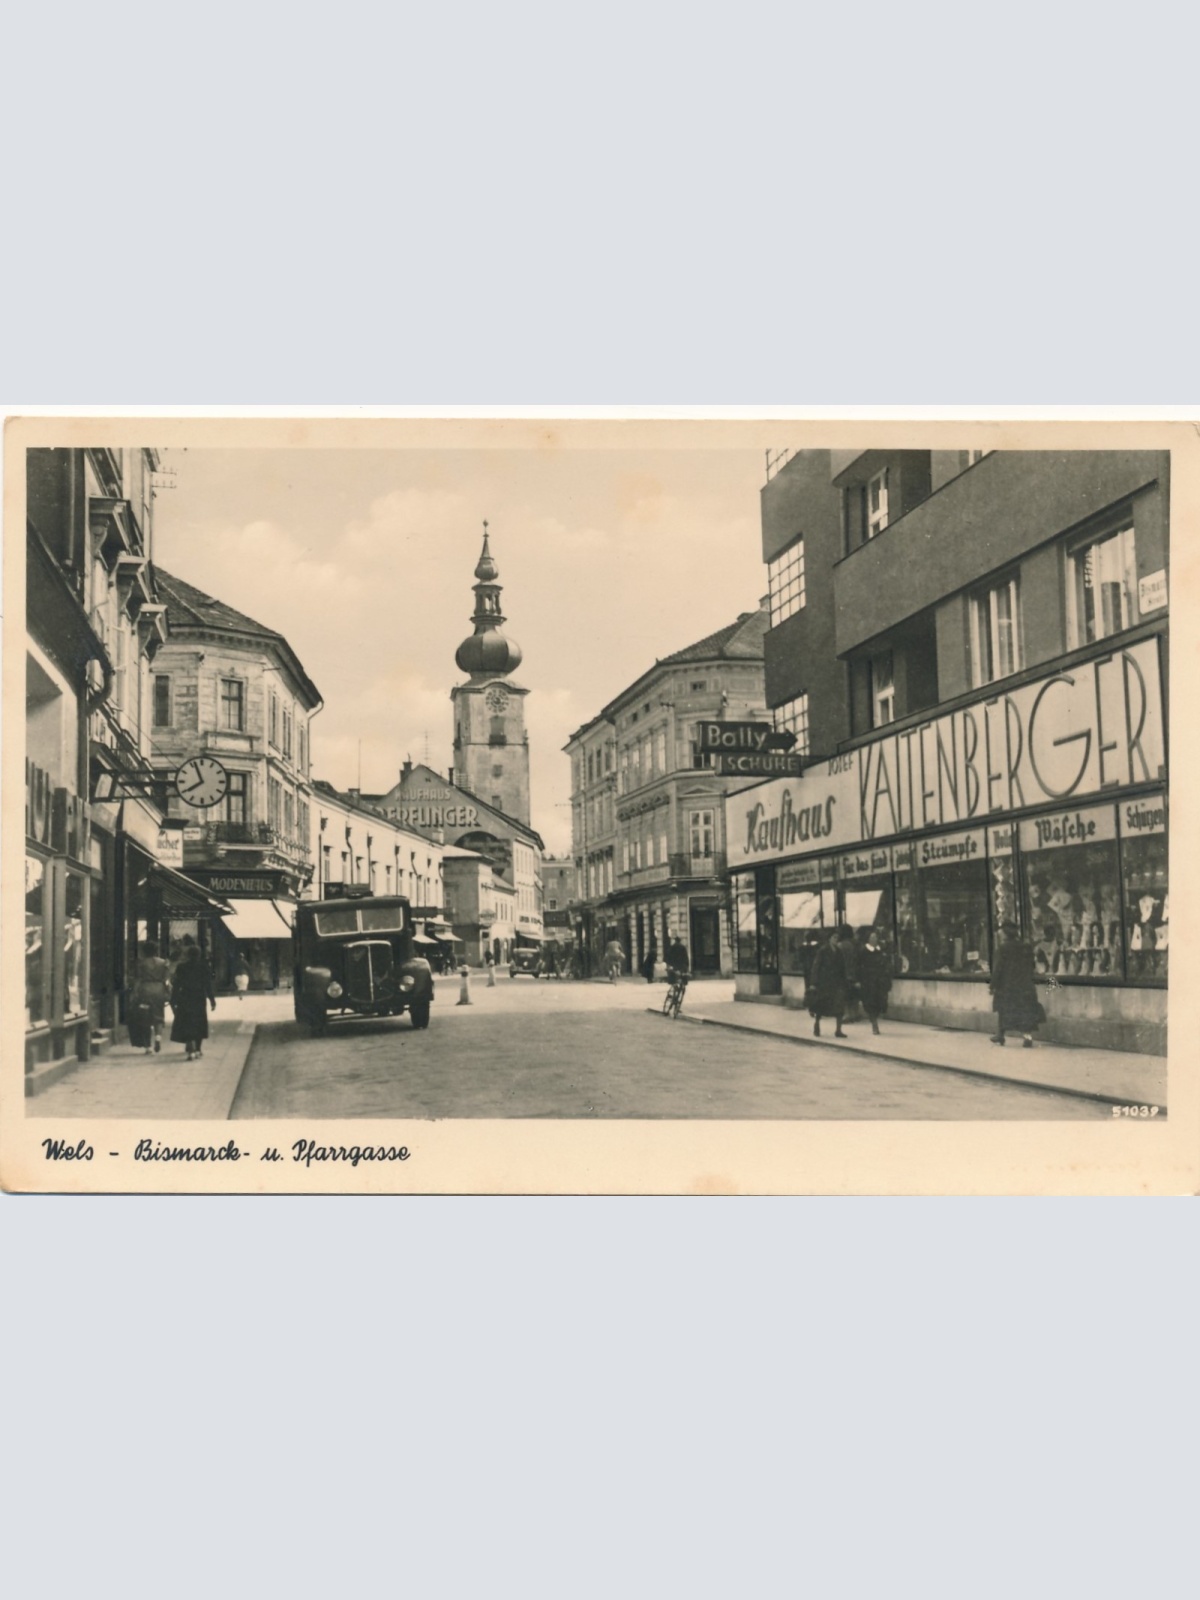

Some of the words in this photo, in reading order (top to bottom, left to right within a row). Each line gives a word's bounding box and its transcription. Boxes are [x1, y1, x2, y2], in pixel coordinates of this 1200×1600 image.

[707, 724, 767, 749] Bally
[726, 756, 797, 772] SCHUHE
[827, 757, 854, 777] JOSEF
[743, 788, 837, 855] Kaufhaus
[1035, 813, 1096, 849] Wäsche
[922, 834, 977, 864] Strümpfe
